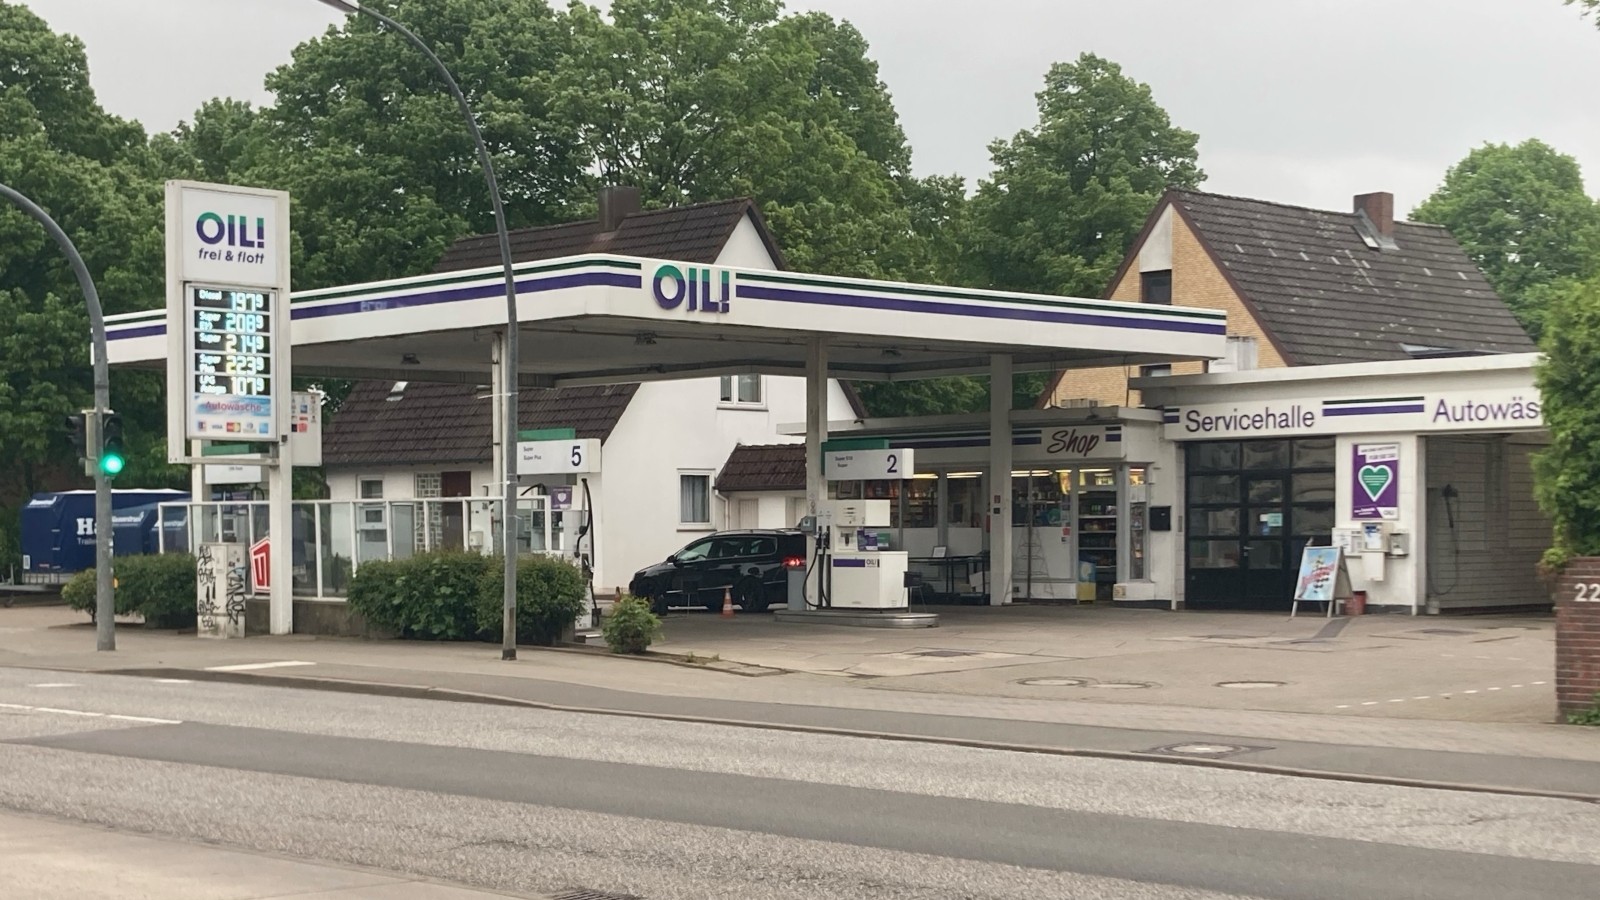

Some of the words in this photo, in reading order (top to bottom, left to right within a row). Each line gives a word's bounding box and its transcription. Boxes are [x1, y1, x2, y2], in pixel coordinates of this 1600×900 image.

[196, 211, 265, 248] OIL!
[199, 248, 221, 261] frei
[225, 250, 233, 262] &
[238, 251, 264, 264] flott
[653, 264, 730, 313] OIL!
[1185, 405, 1315, 432] Servicehalle
[571, 445, 582, 467] 5
[1046, 428, 1099, 457] Shop
[887, 454, 898, 473] 2
